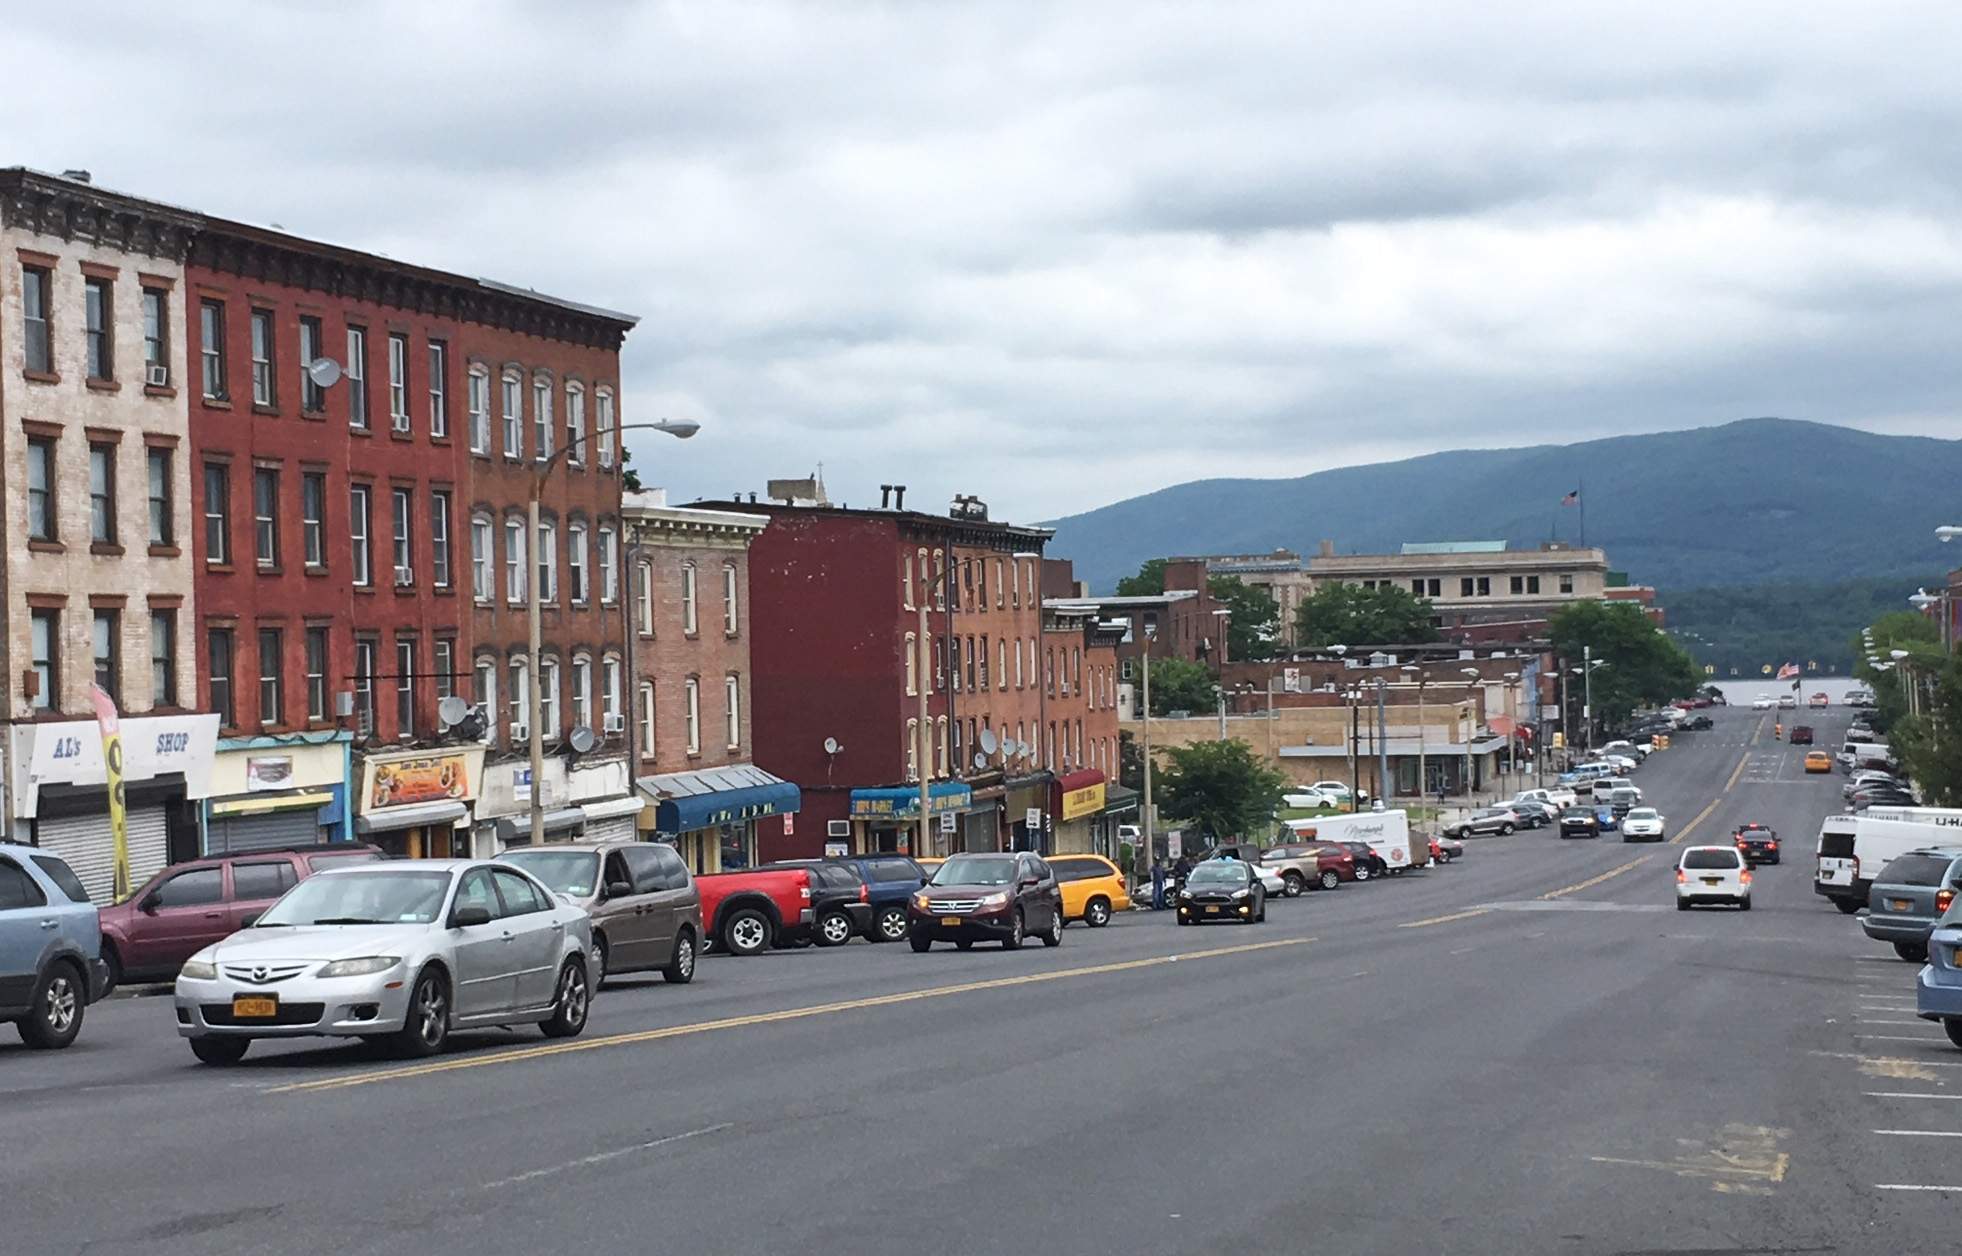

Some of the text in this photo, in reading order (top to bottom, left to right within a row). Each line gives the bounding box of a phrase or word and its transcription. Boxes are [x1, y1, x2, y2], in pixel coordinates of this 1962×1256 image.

[53, 732, 190, 759] AL's SHOP
[1935, 817, 1962, 827] U-H
